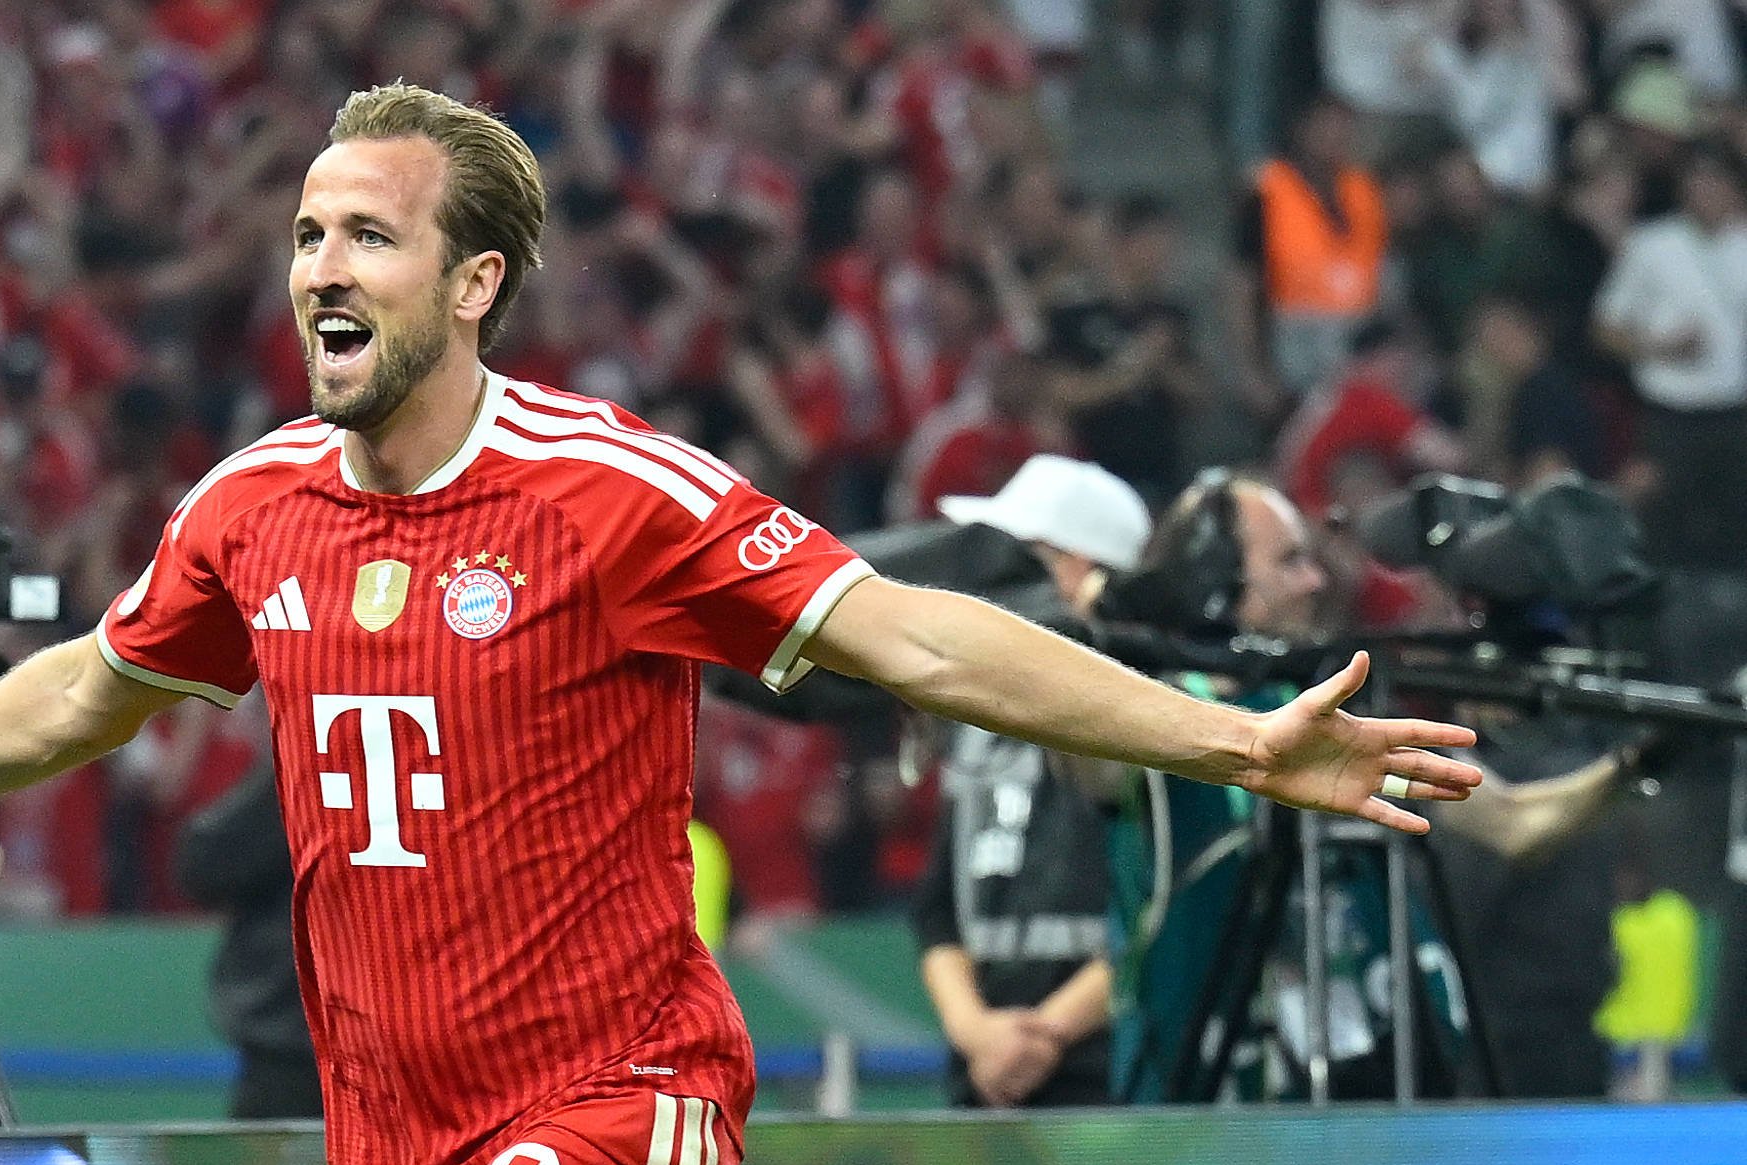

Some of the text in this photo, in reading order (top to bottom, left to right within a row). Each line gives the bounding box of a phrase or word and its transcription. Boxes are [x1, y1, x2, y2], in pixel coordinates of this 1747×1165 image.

[450, 574, 507, 600] FC BAYERN
[312, 694, 445, 867] T
